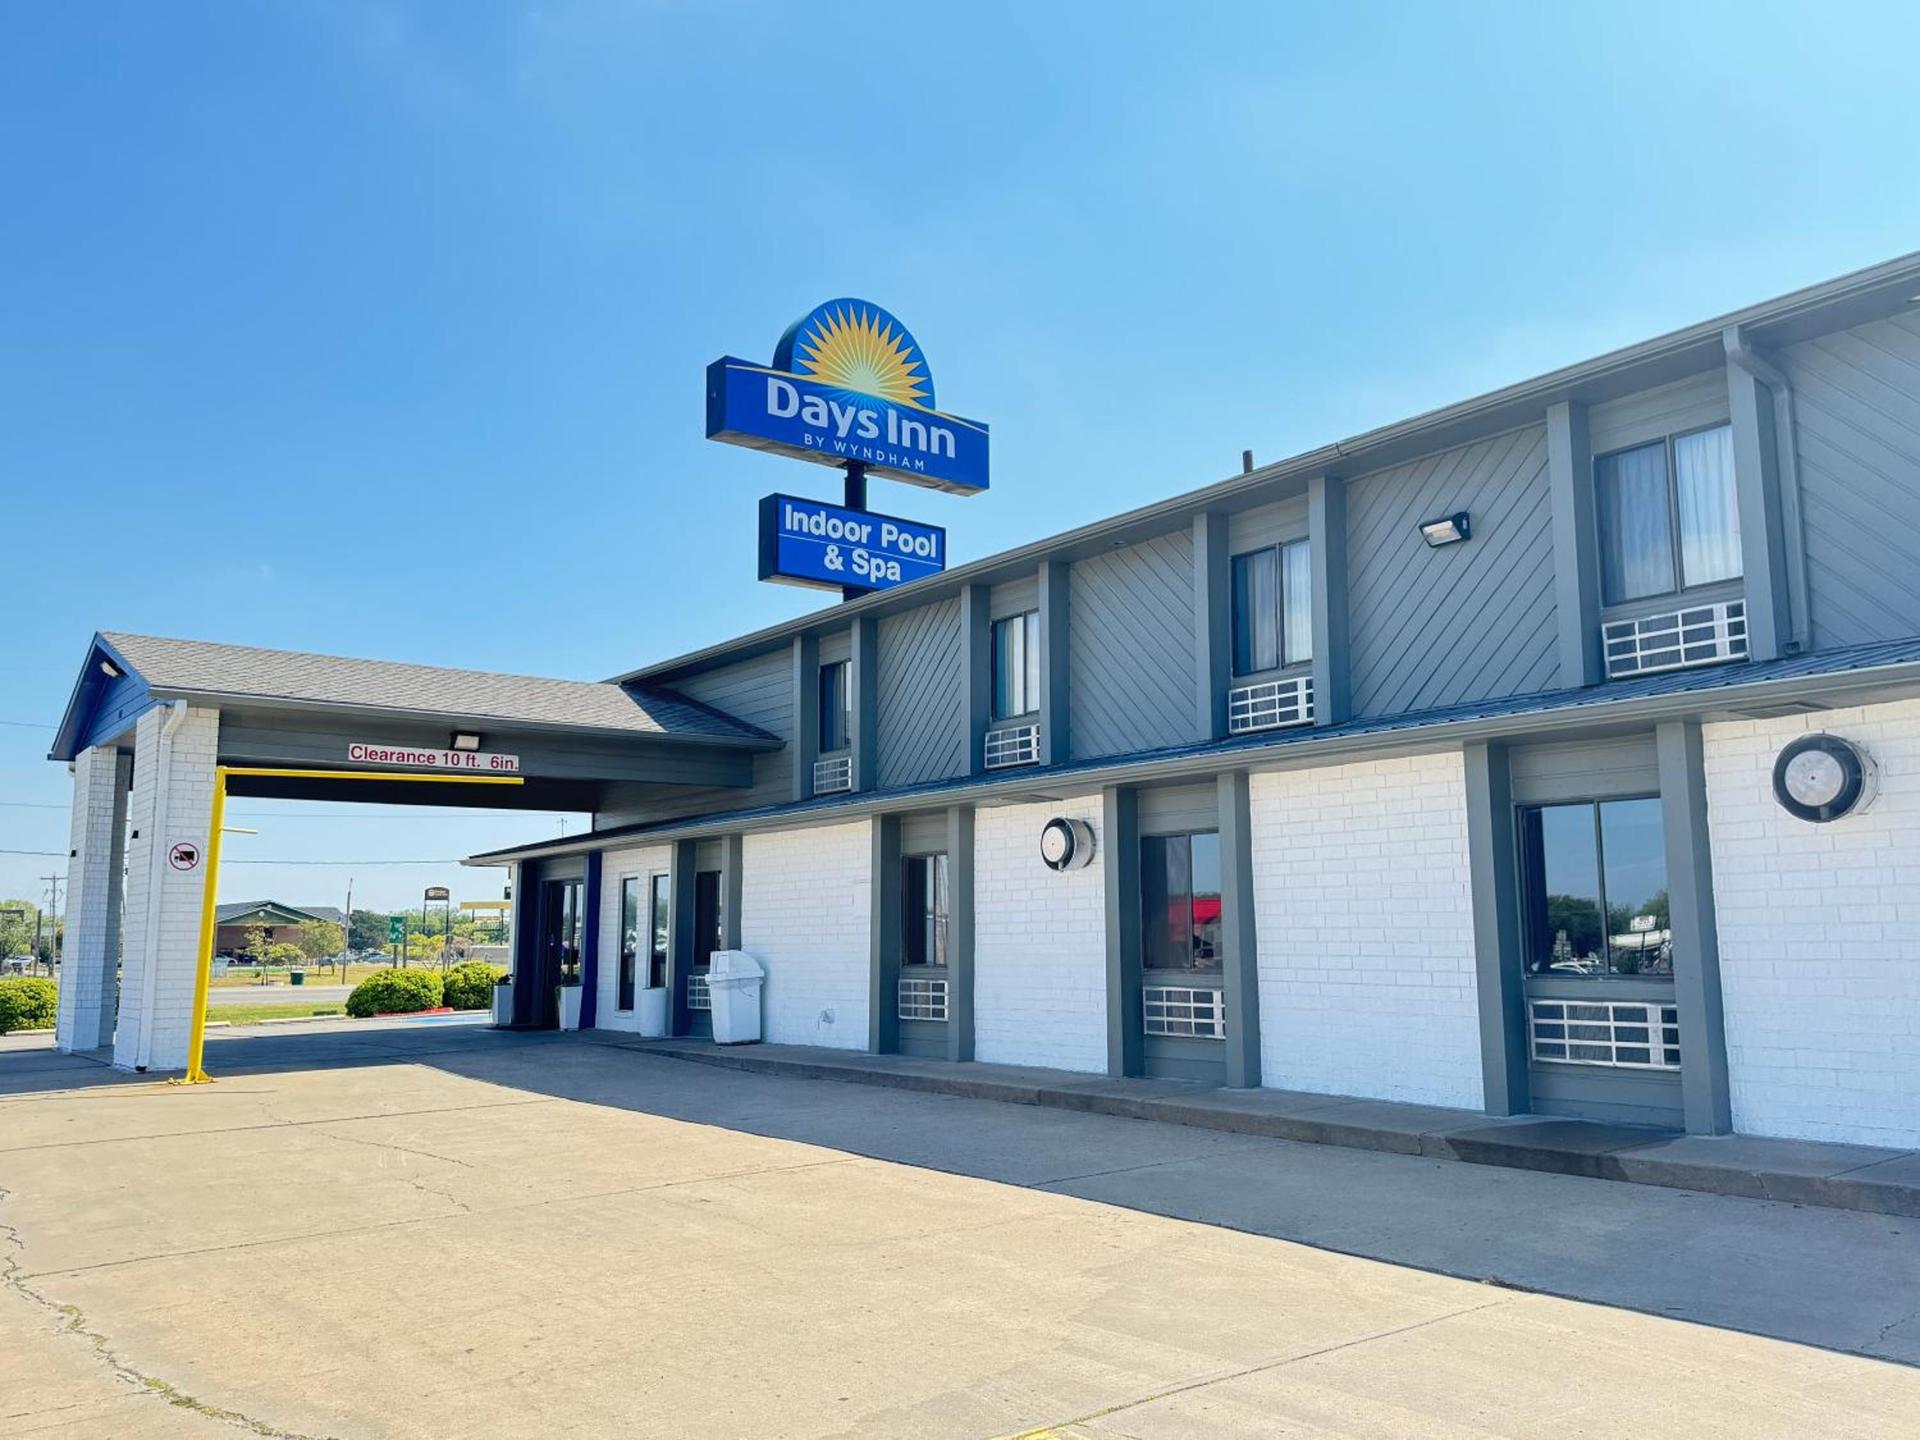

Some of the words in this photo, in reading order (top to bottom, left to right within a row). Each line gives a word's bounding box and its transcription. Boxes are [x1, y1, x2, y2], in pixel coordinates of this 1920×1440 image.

[767, 377, 880, 439] Days
[887, 408, 955, 458] Inn
[804, 433, 825, 448] BY
[834, 442, 925, 471] WYNDHAM
[785, 504, 872, 544] Indoor
[881, 523, 937, 558] Pool
[824, 545, 844, 571] &
[852, 551, 901, 583] Spa
[350, 745, 436, 765] Clearance
[442, 752, 460, 767] 10
[466, 754, 481, 768] ft.
